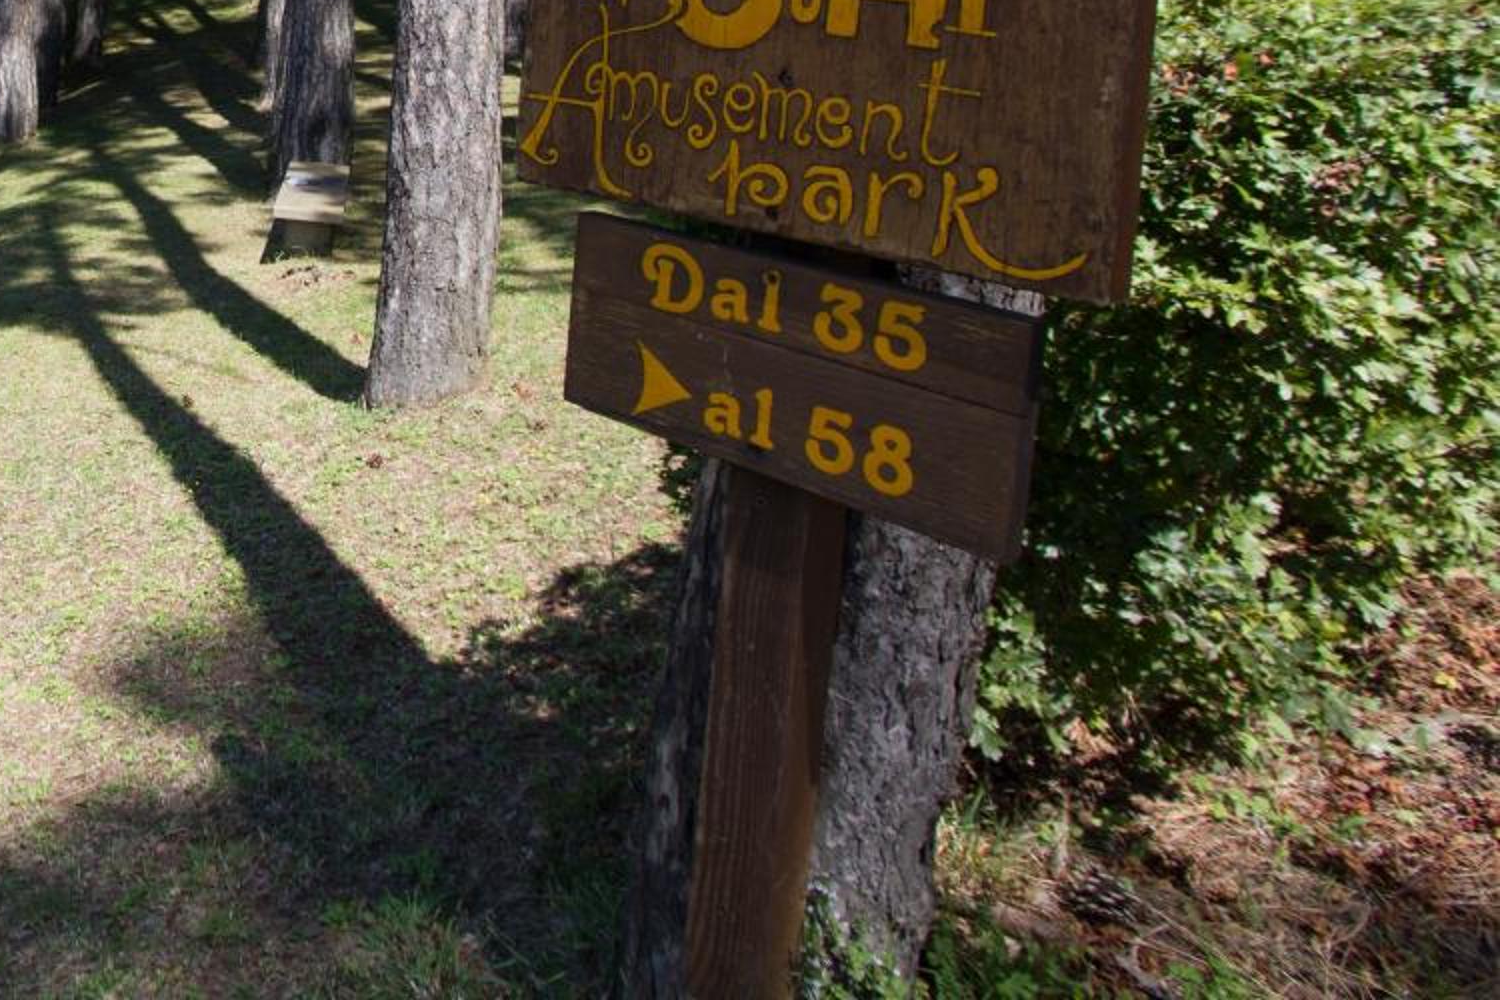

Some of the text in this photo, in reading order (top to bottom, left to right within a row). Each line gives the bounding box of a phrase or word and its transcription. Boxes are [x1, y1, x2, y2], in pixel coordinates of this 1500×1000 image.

[519, 2, 982, 197] Amusement
[641, 242, 929, 372] Dal 35
[704, 388, 914, 498] al 58
